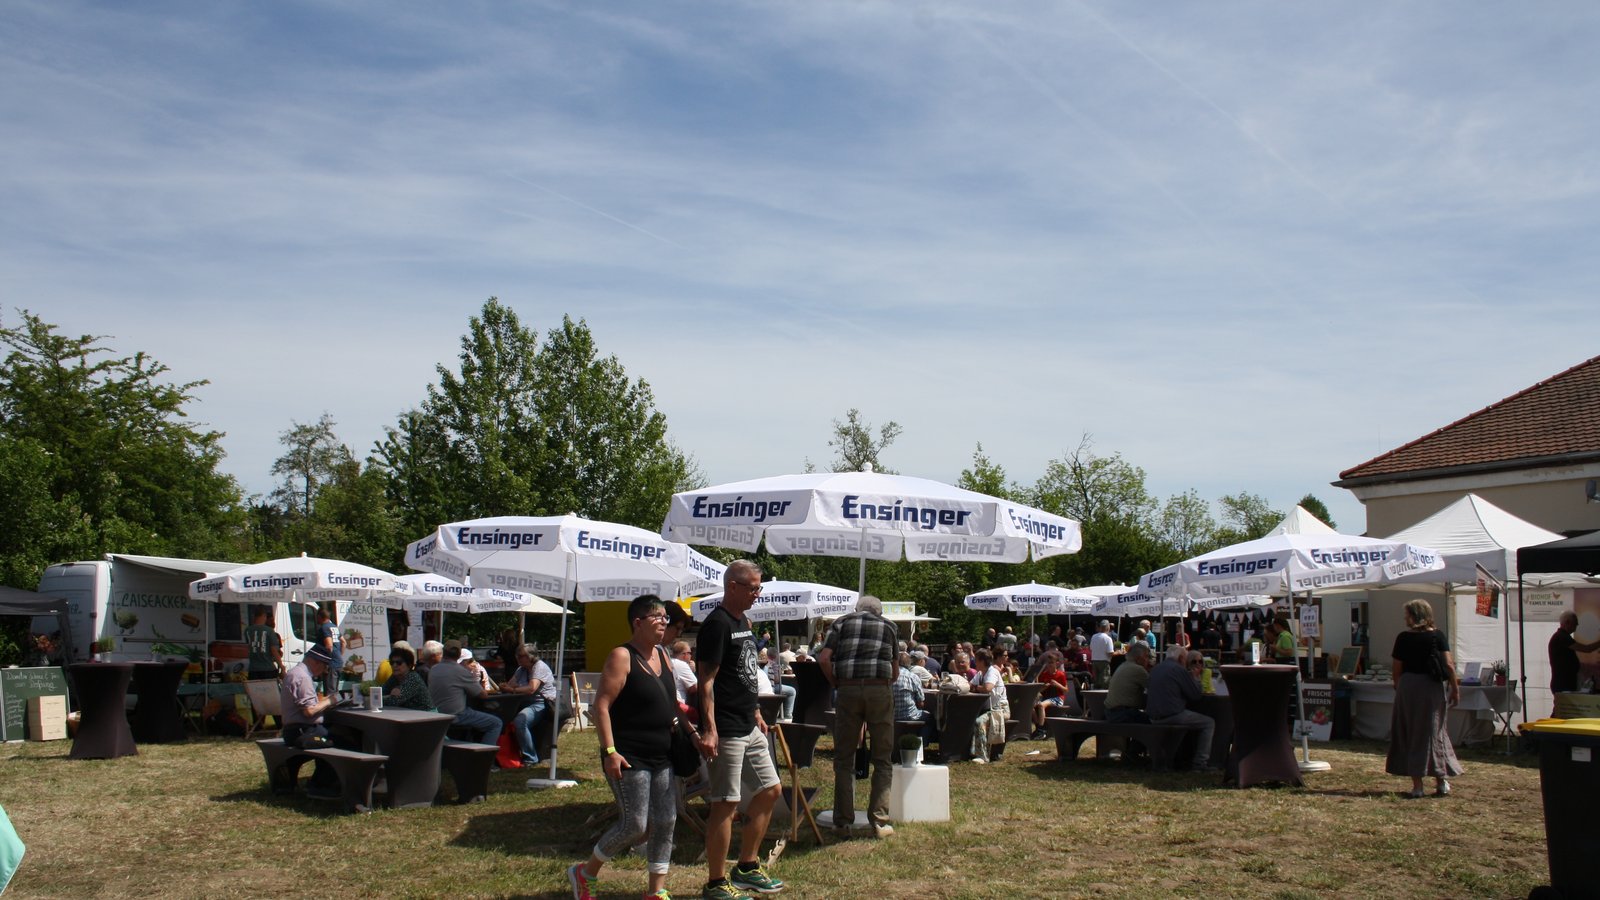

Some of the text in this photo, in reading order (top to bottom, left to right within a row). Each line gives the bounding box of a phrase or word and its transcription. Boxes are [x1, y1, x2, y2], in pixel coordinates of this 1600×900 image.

[692, 496, 792, 523] Ensinger
[841, 495, 972, 530] Ensinger
[457, 528, 543, 549] Ensinger
[577, 531, 666, 560] Ensinger
[1311, 548, 1390, 565] Ensinger
[1198, 558, 1278, 576] Ensinger
[197, 580, 225, 594] Ensinger
[243, 575, 305, 589] Ensinger
[328, 573, 382, 588] Ensinger
[424, 582, 476, 596] Ensinger
[816, 592, 852, 604] Ensinger
[971, 596, 999, 605] Ensinger
[1011, 595, 1052, 605] Ensinger
[699, 600, 721, 611] Ensin
[1307, 690, 1332, 698] FRISCHE
